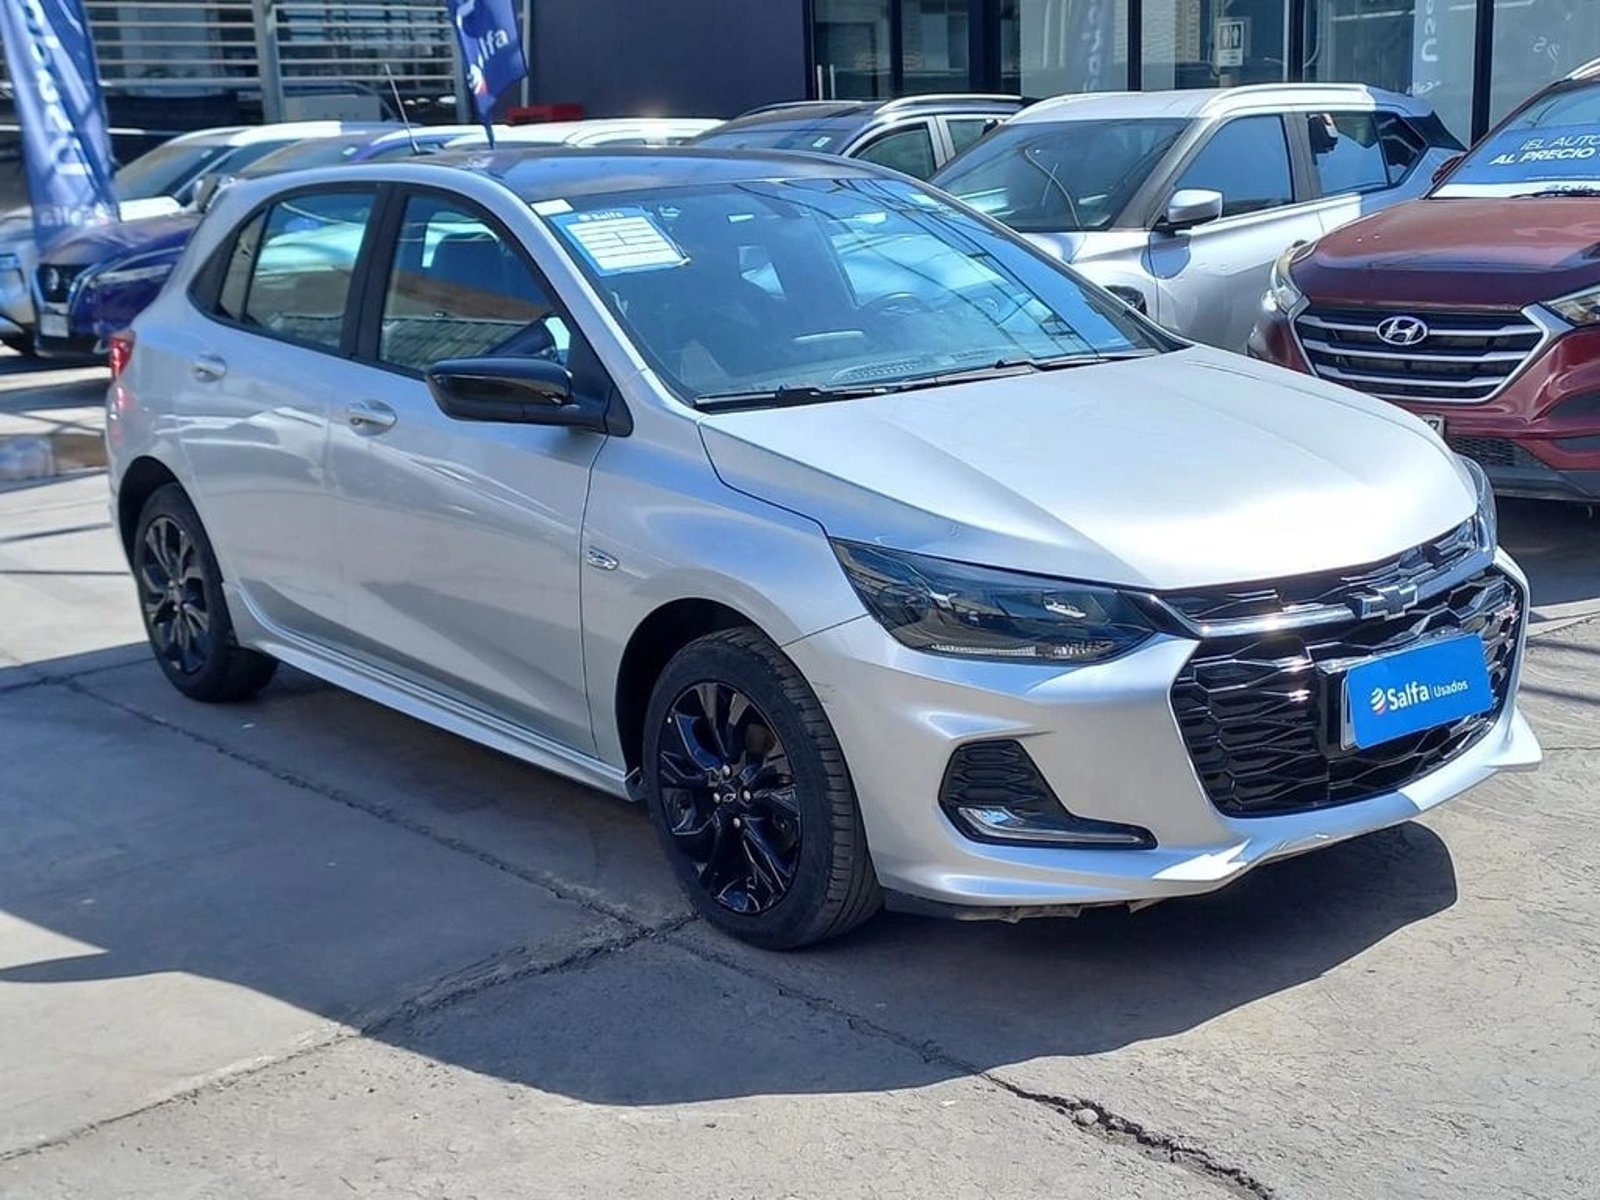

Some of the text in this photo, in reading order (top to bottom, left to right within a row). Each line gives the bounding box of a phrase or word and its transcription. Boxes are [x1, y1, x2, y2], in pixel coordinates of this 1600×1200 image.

[1489, 147, 1596, 166] AL PRECIO
[1387, 679, 1468, 710] Salfa Usados
